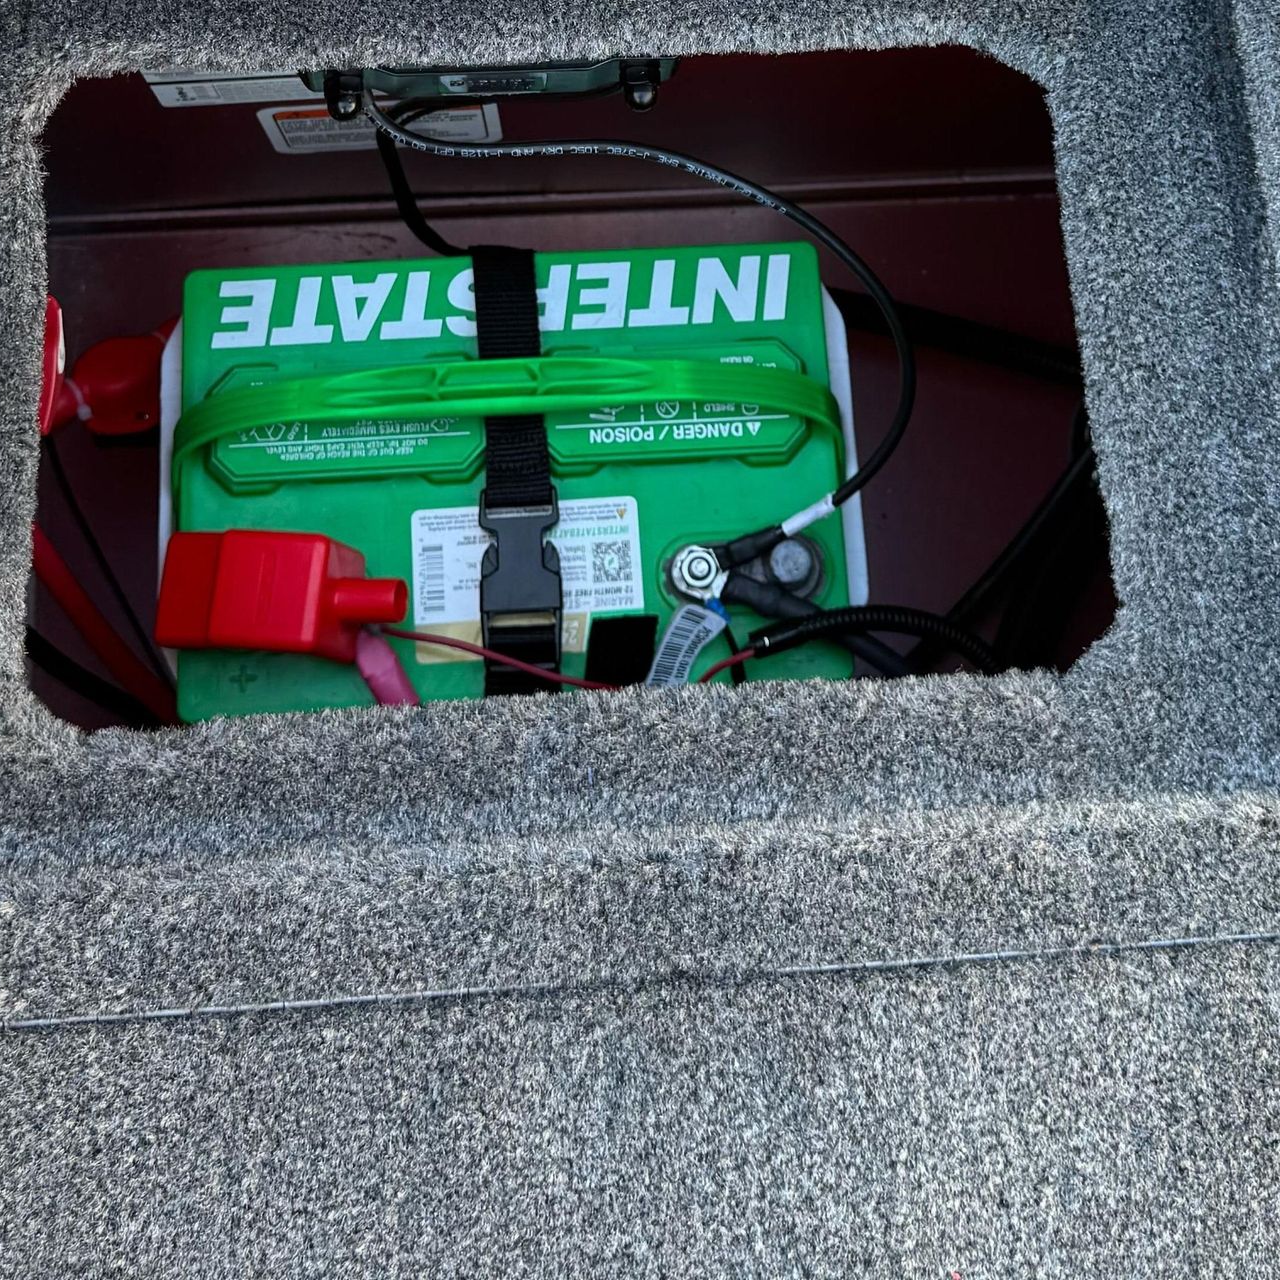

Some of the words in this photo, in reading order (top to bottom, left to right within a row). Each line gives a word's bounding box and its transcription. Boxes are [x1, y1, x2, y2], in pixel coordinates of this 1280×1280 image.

[511, 148, 534, 158] AND
[540, 146, 563, 156] DRY
[686, 163, 727, 186] MARINE
[321, 425, 377, 437] IMMEDIATELY
[379, 424, 401, 434] EYES
[402, 422, 430, 432] FLUSH
[672, 422, 743, 440] DANGER
[589, 426, 654, 443] POISON
[352, 449, 366, 457] THE
